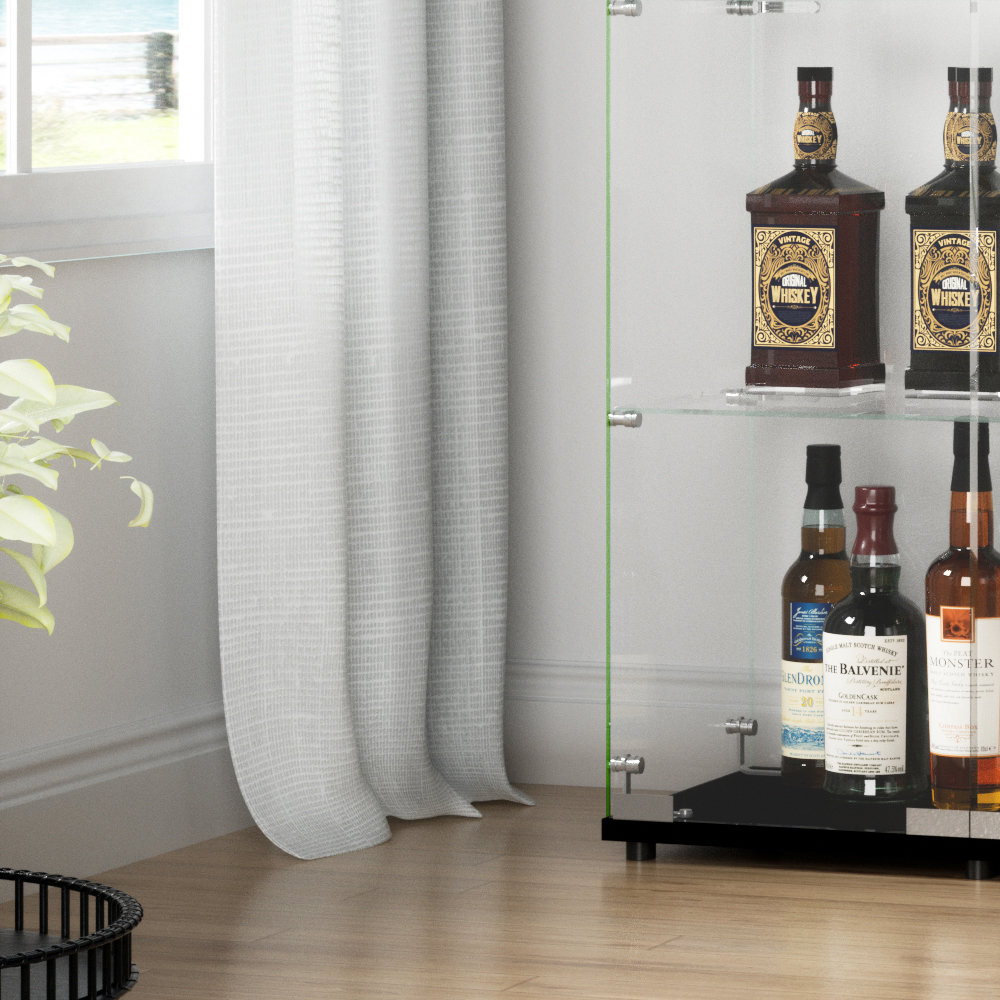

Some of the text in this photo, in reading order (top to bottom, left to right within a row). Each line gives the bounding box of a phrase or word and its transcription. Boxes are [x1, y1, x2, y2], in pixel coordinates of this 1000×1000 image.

[777, 235, 812, 246] VINTAGE
[938, 237, 972, 248] VINTAGE
[781, 273, 808, 287] ORIGINAL
[941, 276, 968, 290] ORIGINAL
[770, 285, 819, 304] WHISKEY
[930, 288, 980, 307] WHISKEY
[853, 642, 876, 650] SCOTCH
[876, 646, 898, 657] WHISKY
[824, 662, 903, 676] THE BALVENIE
[929, 656, 994, 669] MONSTER
[782, 672, 824, 686] LENDRO
[801, 696, 814, 708] 20
